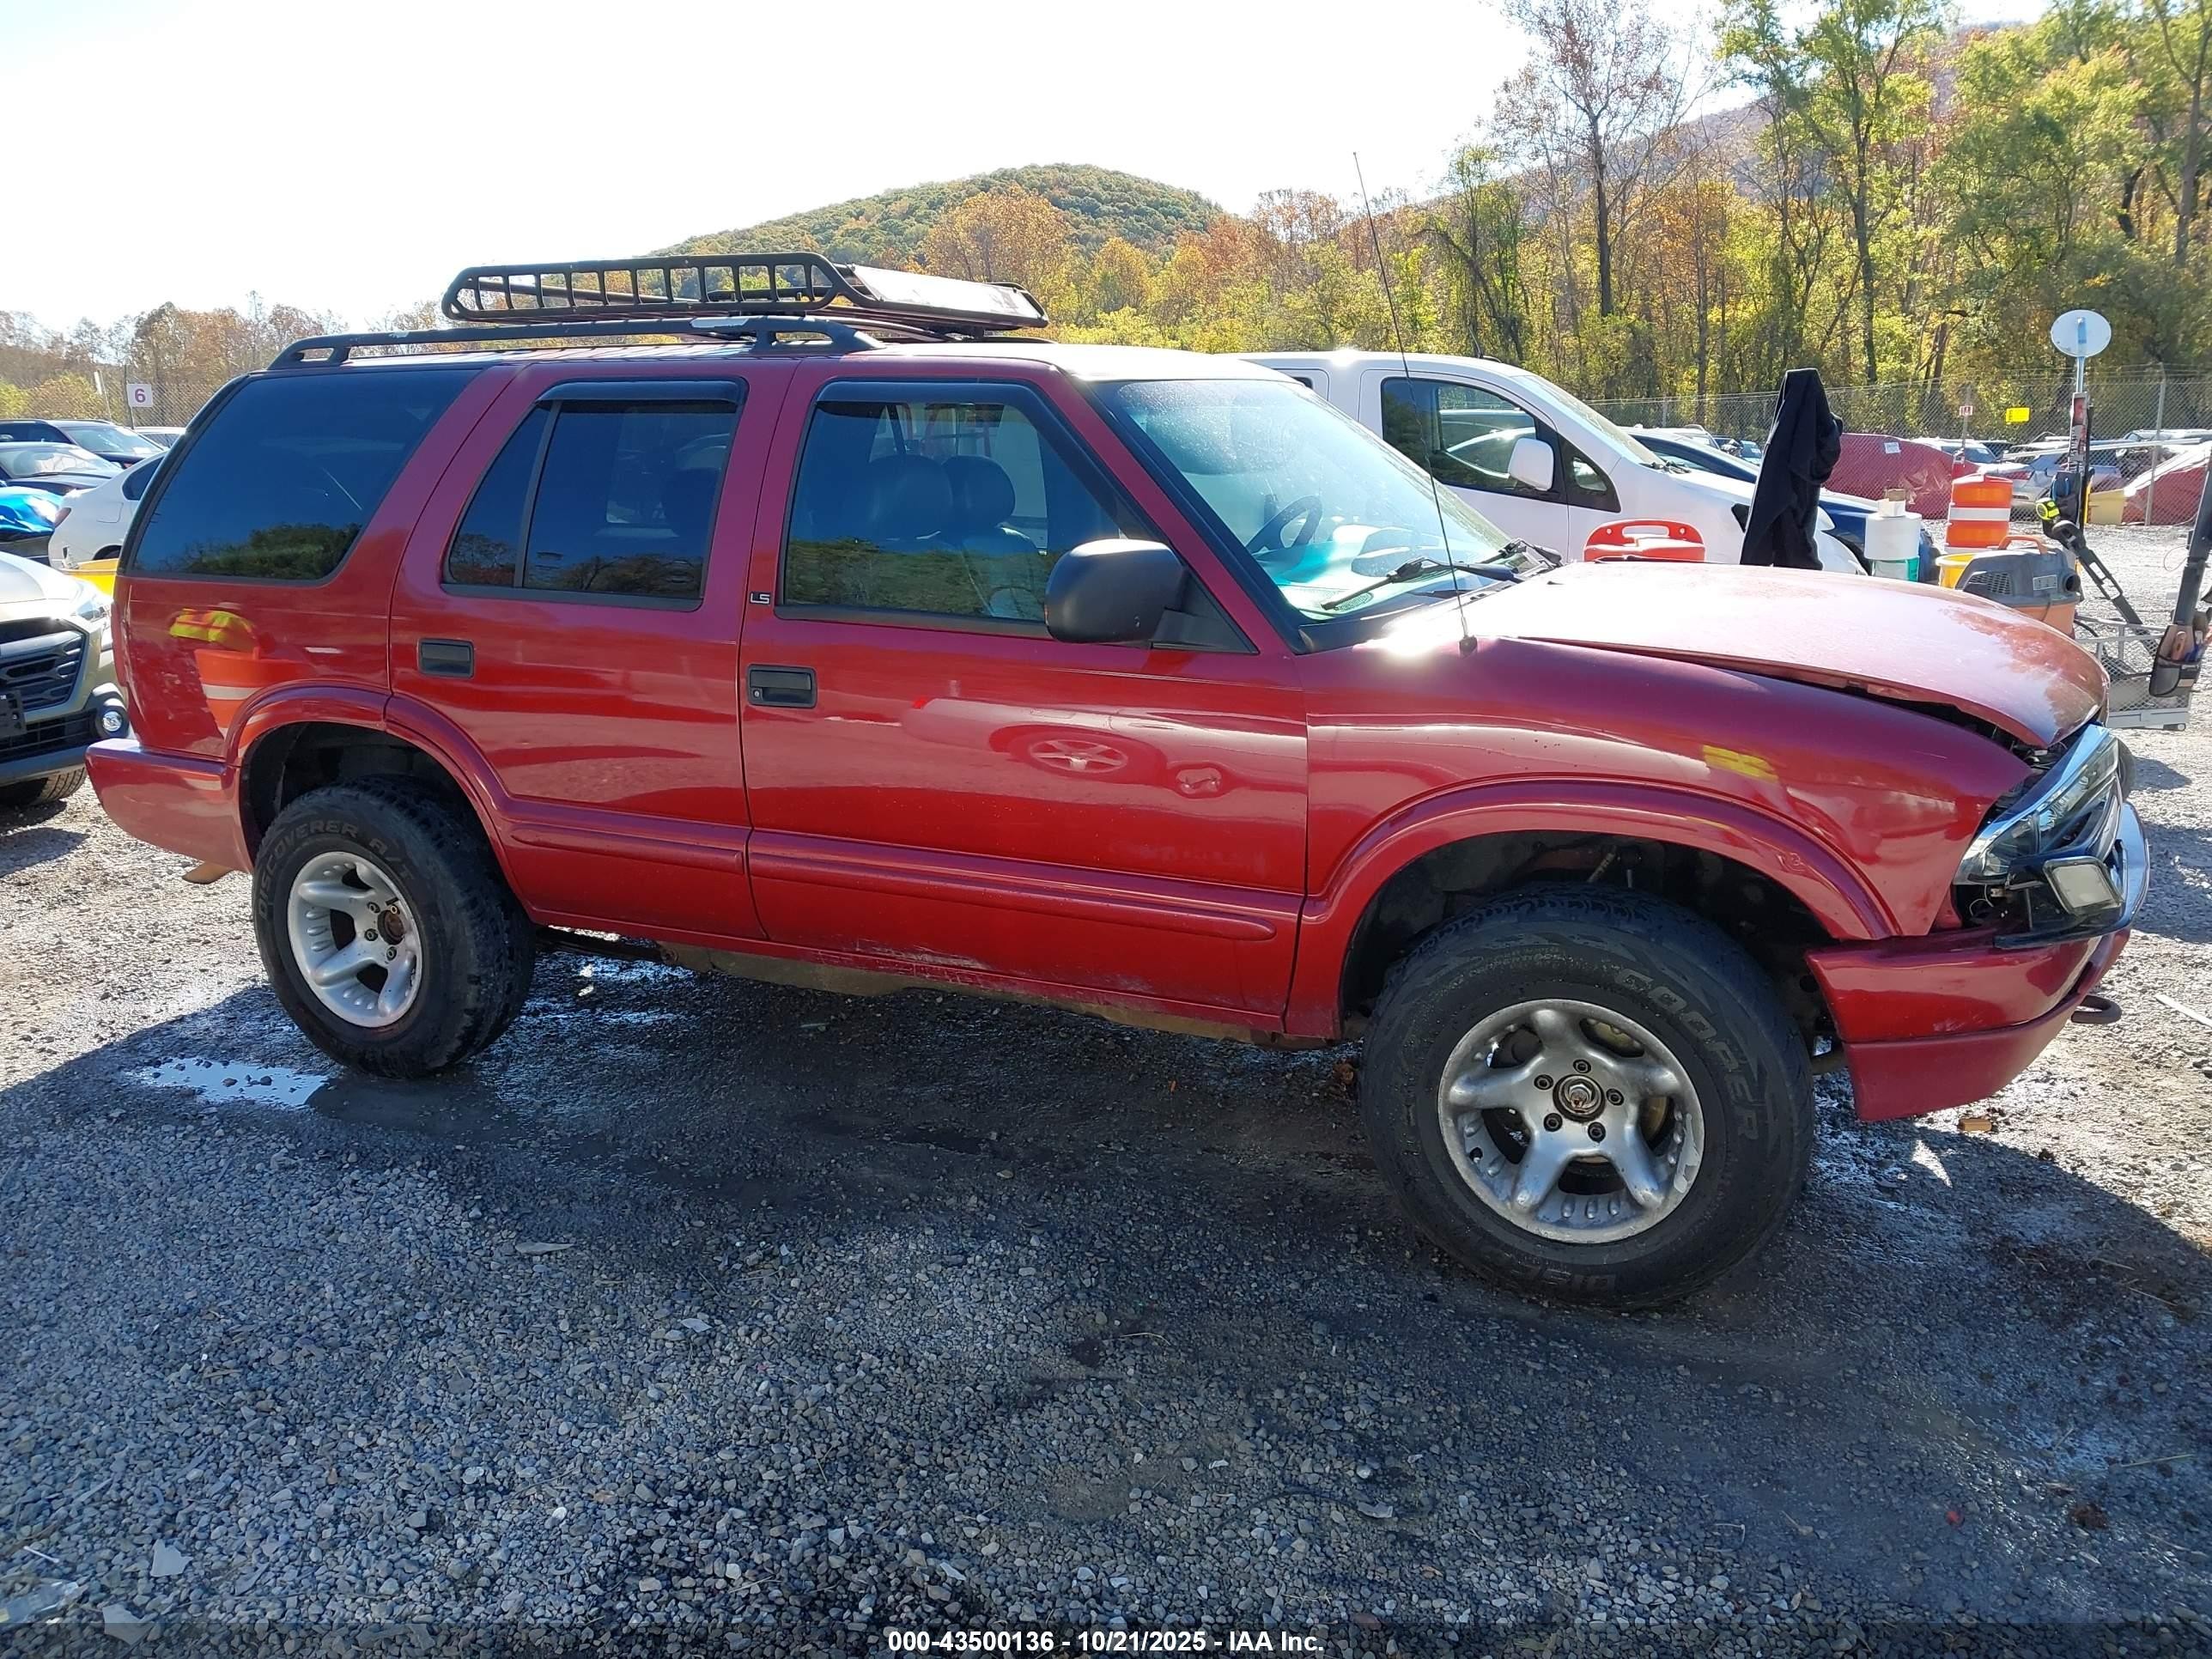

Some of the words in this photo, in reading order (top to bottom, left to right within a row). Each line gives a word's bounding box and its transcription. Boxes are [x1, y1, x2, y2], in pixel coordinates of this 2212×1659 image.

[135, 388, 146, 403] 6
[750, 592, 769, 605] LS
[258, 819, 359, 921] DISCOVERER
[369, 837, 415, 881] A/T
[1614, 968, 1759, 1140] COOPER
